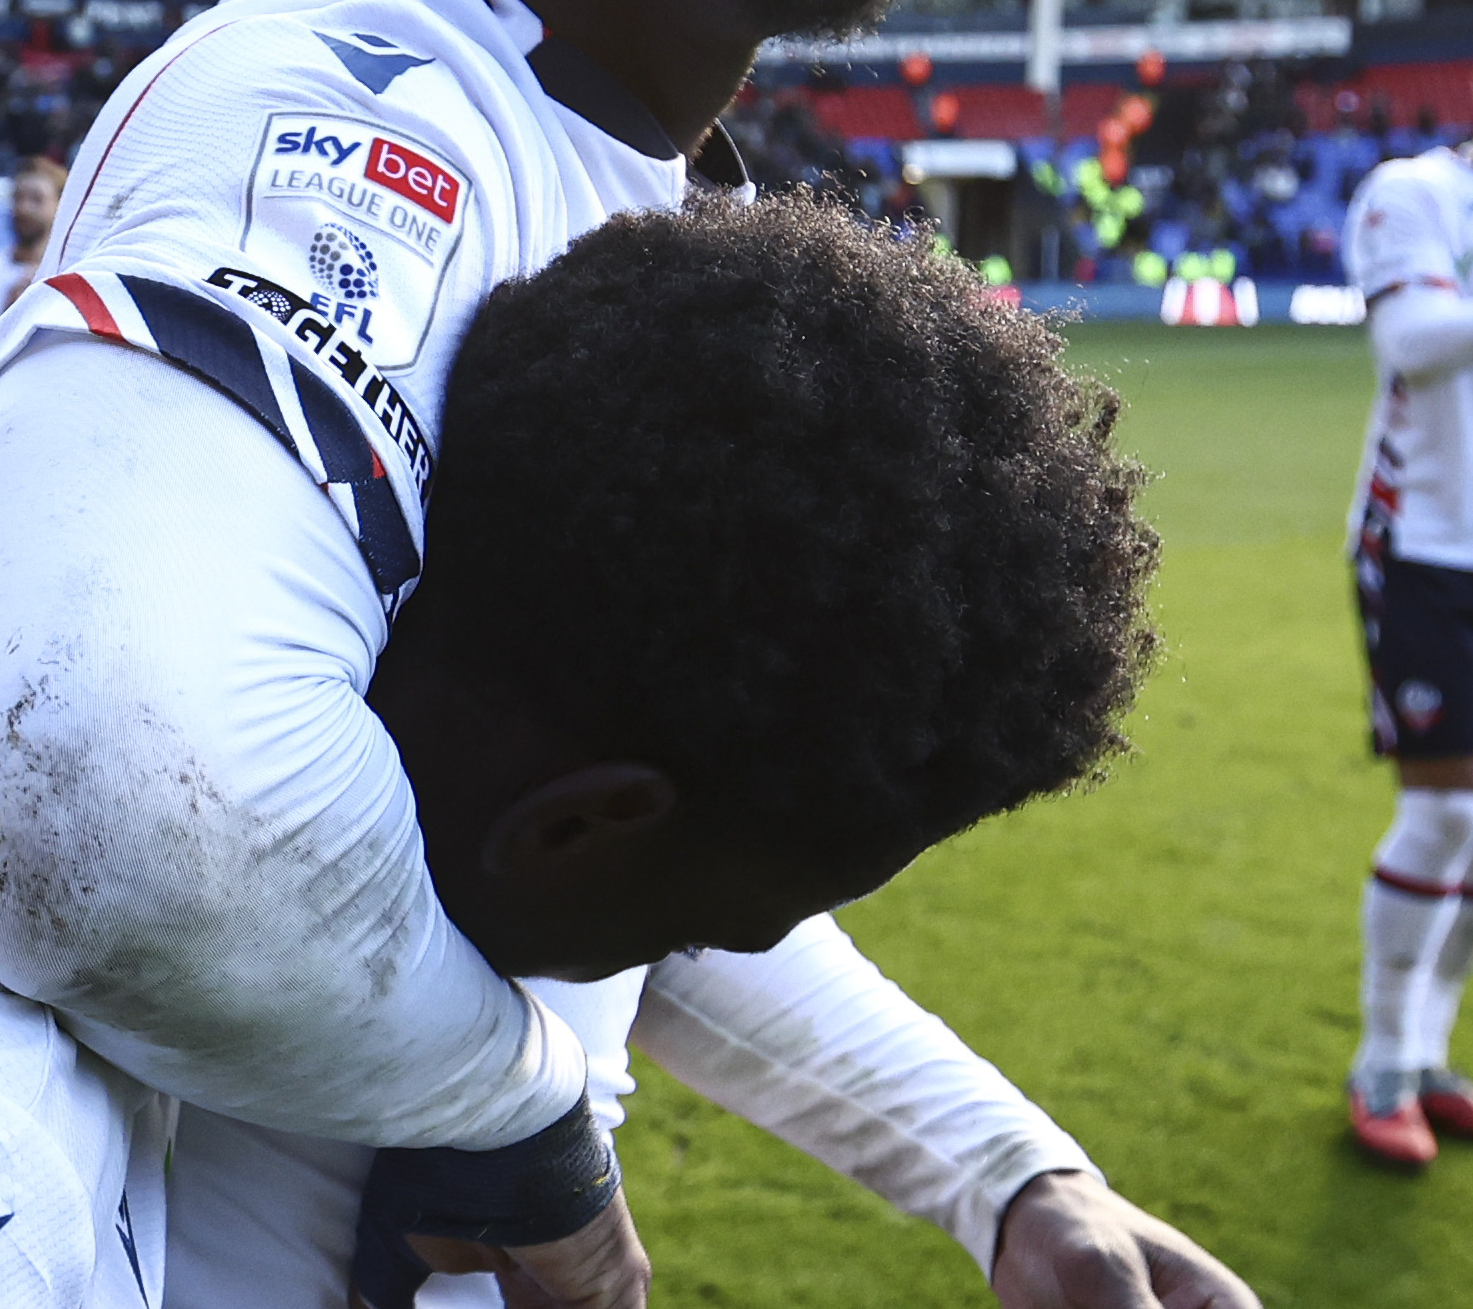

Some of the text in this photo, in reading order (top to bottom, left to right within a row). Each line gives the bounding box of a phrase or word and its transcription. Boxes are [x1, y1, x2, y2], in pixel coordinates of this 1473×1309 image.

[275, 127, 451, 206] sky bet
[270, 169, 441, 253] LEAGUE ONE
[311, 292, 373, 344] EFL
